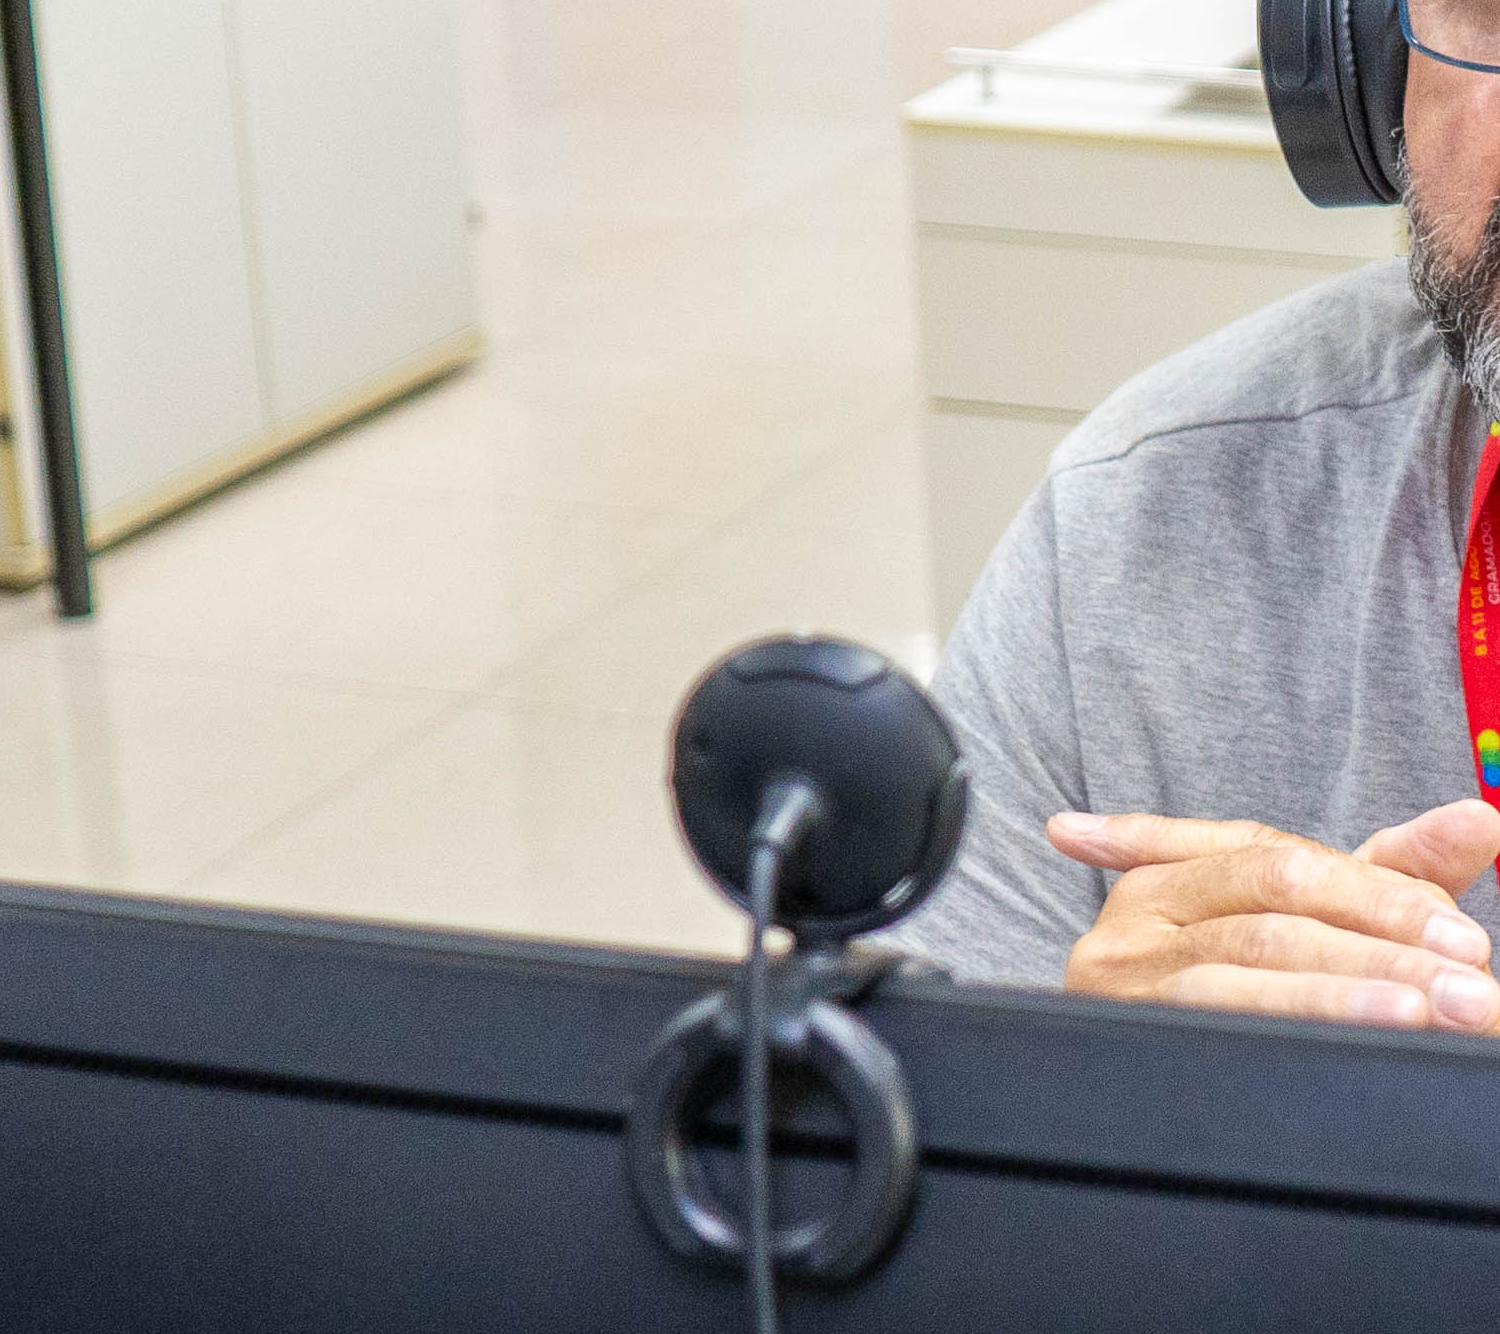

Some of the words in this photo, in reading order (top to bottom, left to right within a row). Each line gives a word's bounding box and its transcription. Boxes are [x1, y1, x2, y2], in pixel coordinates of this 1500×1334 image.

[1469, 547, 1481, 580] AGO
[1470, 586, 1484, 609] DE
[1473, 628, 1486, 640] A
